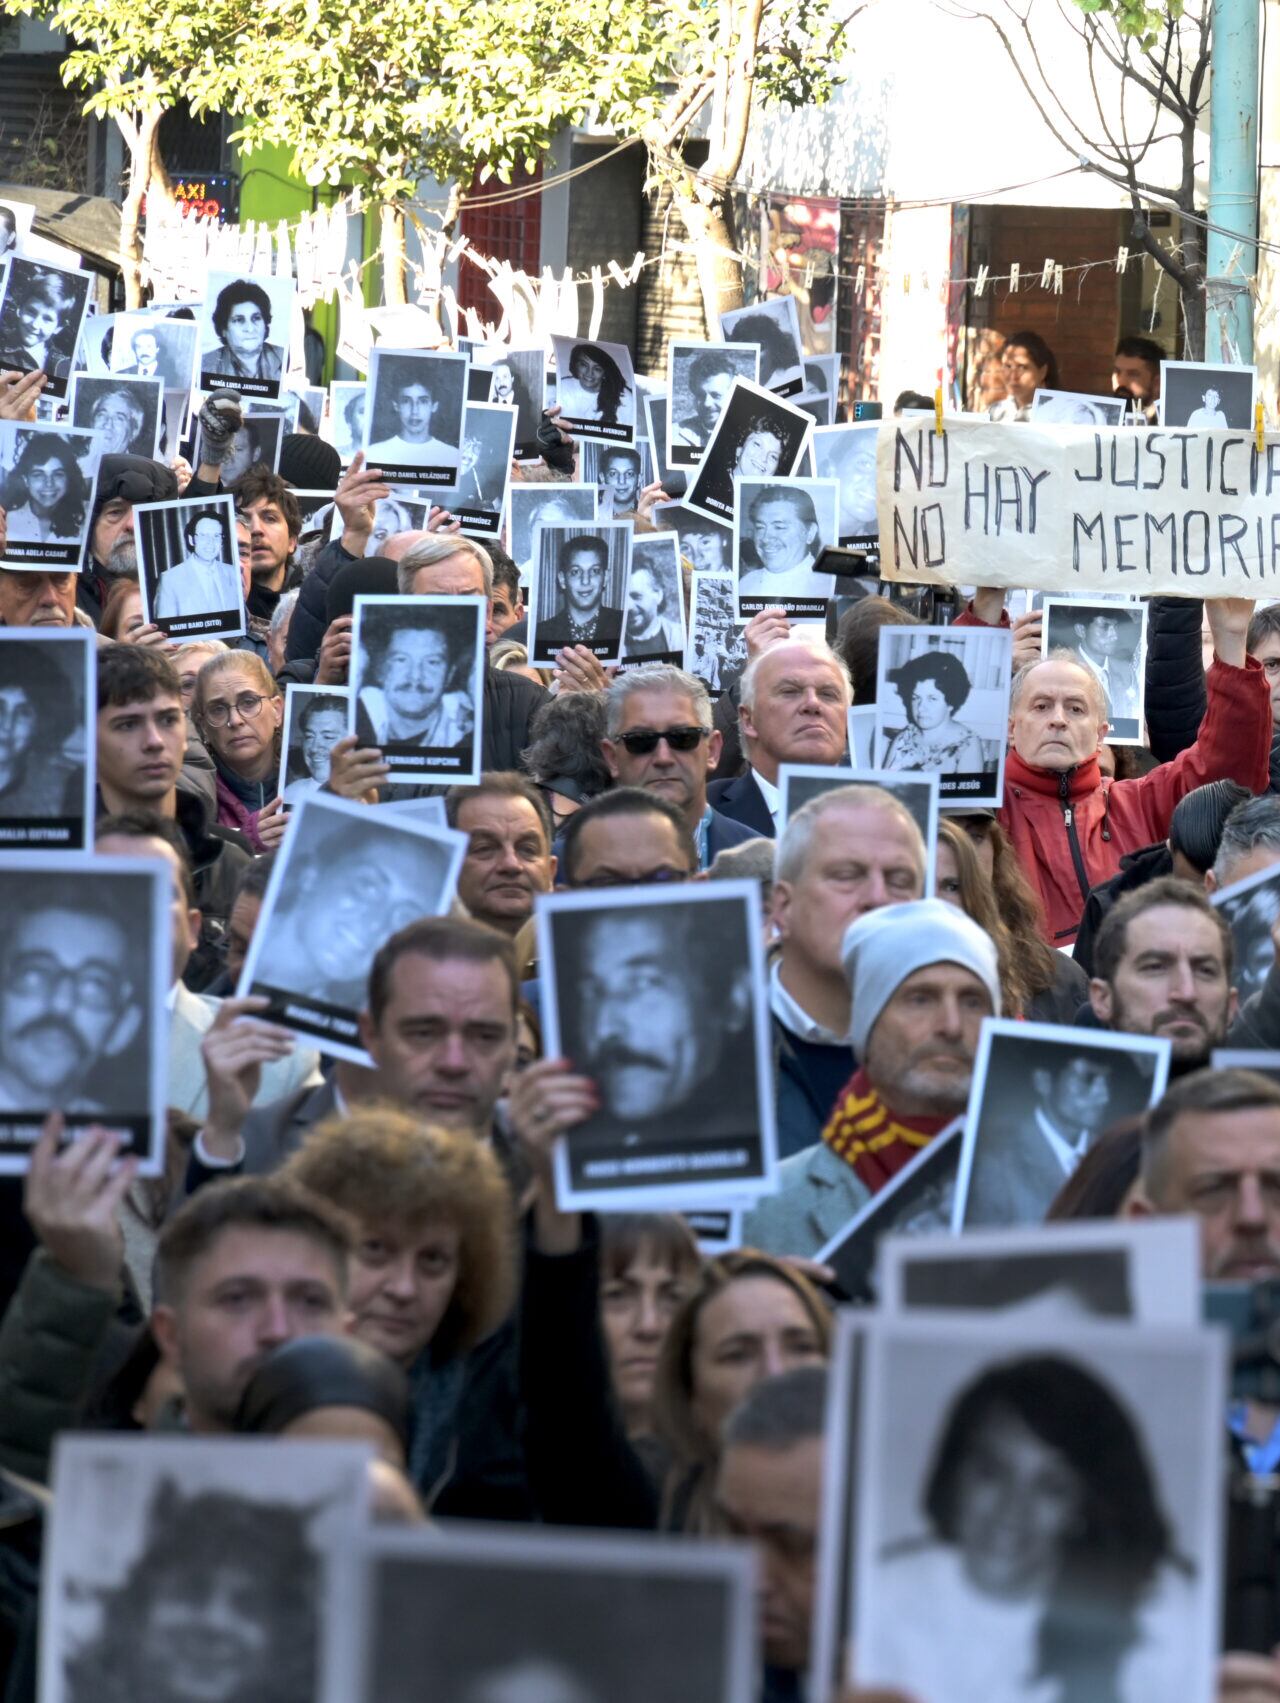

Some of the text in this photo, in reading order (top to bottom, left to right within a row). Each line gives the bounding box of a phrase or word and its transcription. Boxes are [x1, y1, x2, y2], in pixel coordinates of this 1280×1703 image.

[175, 184, 205, 200] AXI
[209, 379, 269, 392] MARÍA LUISA JAWORSKI
[584, 424, 602, 432] MURIEL
[398, 472, 418, 480] DANIEL
[419, 471, 451, 481] VELÁZQUEZ
[893, 427, 949, 492] NO
[964, 462, 1051, 536] HAY
[462, 515, 491, 526] BERMÚDEZ
[893, 503, 947, 570] NO
[846, 542, 872, 550] MARIELA
[26, 549, 44, 557] ADELA
[741, 603, 763, 611] CARLOS
[169, 619, 222, 631] NAUM BAND (SITO)
[957, 779, 981, 790] JESÚS
